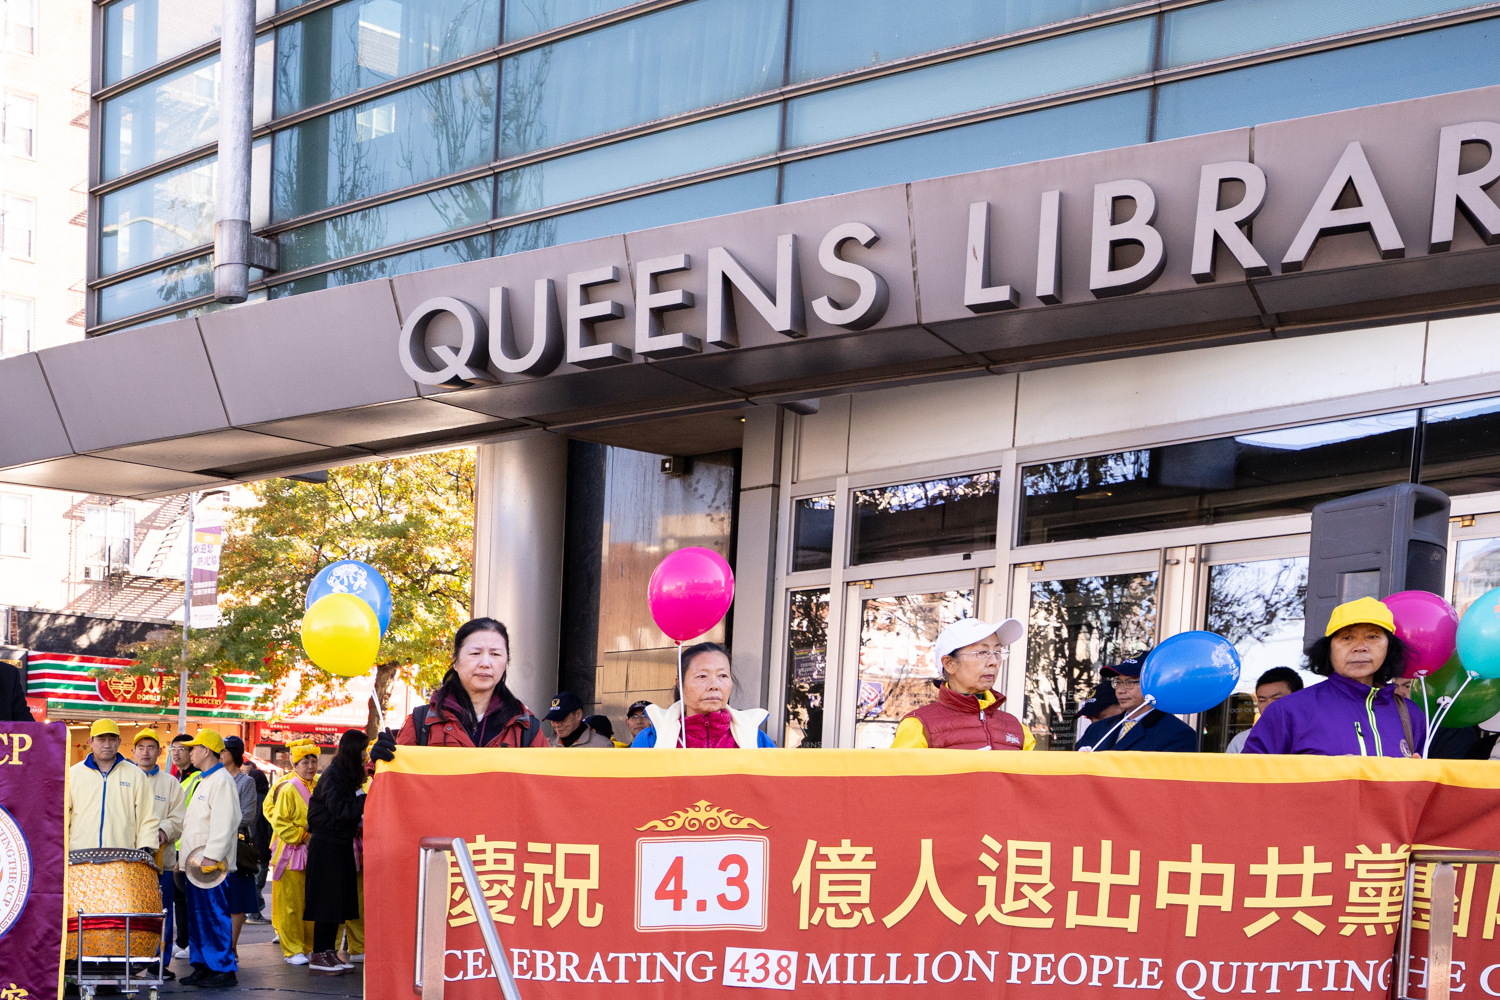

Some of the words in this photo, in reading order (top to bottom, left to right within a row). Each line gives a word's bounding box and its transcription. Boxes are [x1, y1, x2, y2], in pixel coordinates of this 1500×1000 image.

[398, 221, 890, 388] QUEENS
[194, 697, 222, 706] GROCERY
[8, 857, 17, 882] THE
[654, 853, 751, 912] 4.3
[2, 881, 16, 908] CCP
[443, 947, 718, 985] CEEBRATING
[728, 952, 793, 987] 438
[802, 948, 999, 987] MILLION
[1006, 951, 1164, 990] PEOPLE
[1408, 954, 1467, 994] HE
